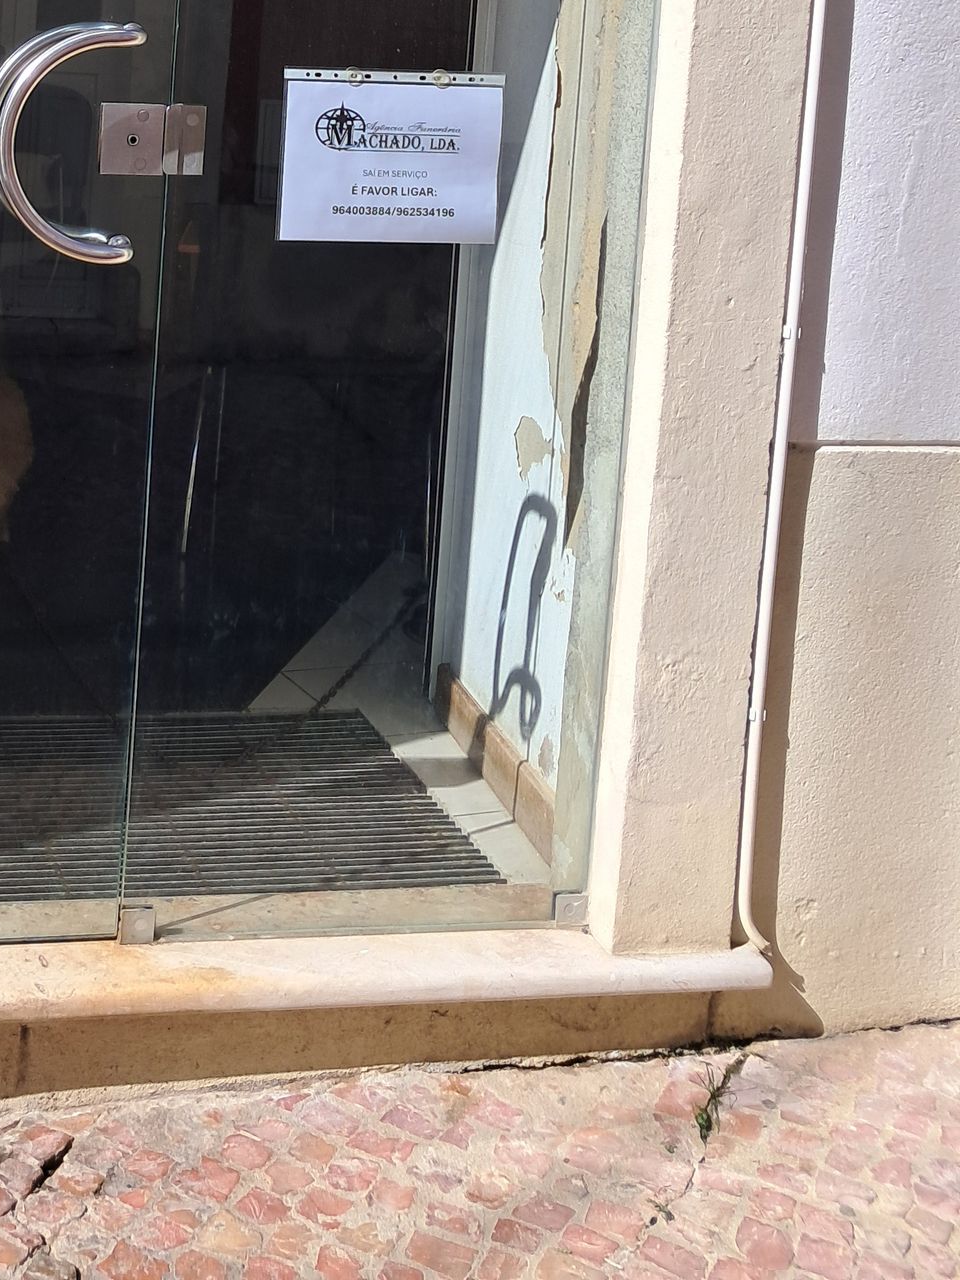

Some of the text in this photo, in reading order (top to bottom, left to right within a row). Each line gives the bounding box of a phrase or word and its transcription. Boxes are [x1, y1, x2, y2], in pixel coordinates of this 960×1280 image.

[429, 137, 460, 151] LDA.
[378, 169, 390, 178] EM
[391, 169, 428, 180] SERVIÇO
[351, 183, 438, 197] É FAVOR LIGAR:
[332, 205, 455, 218] 964003884/962534196
